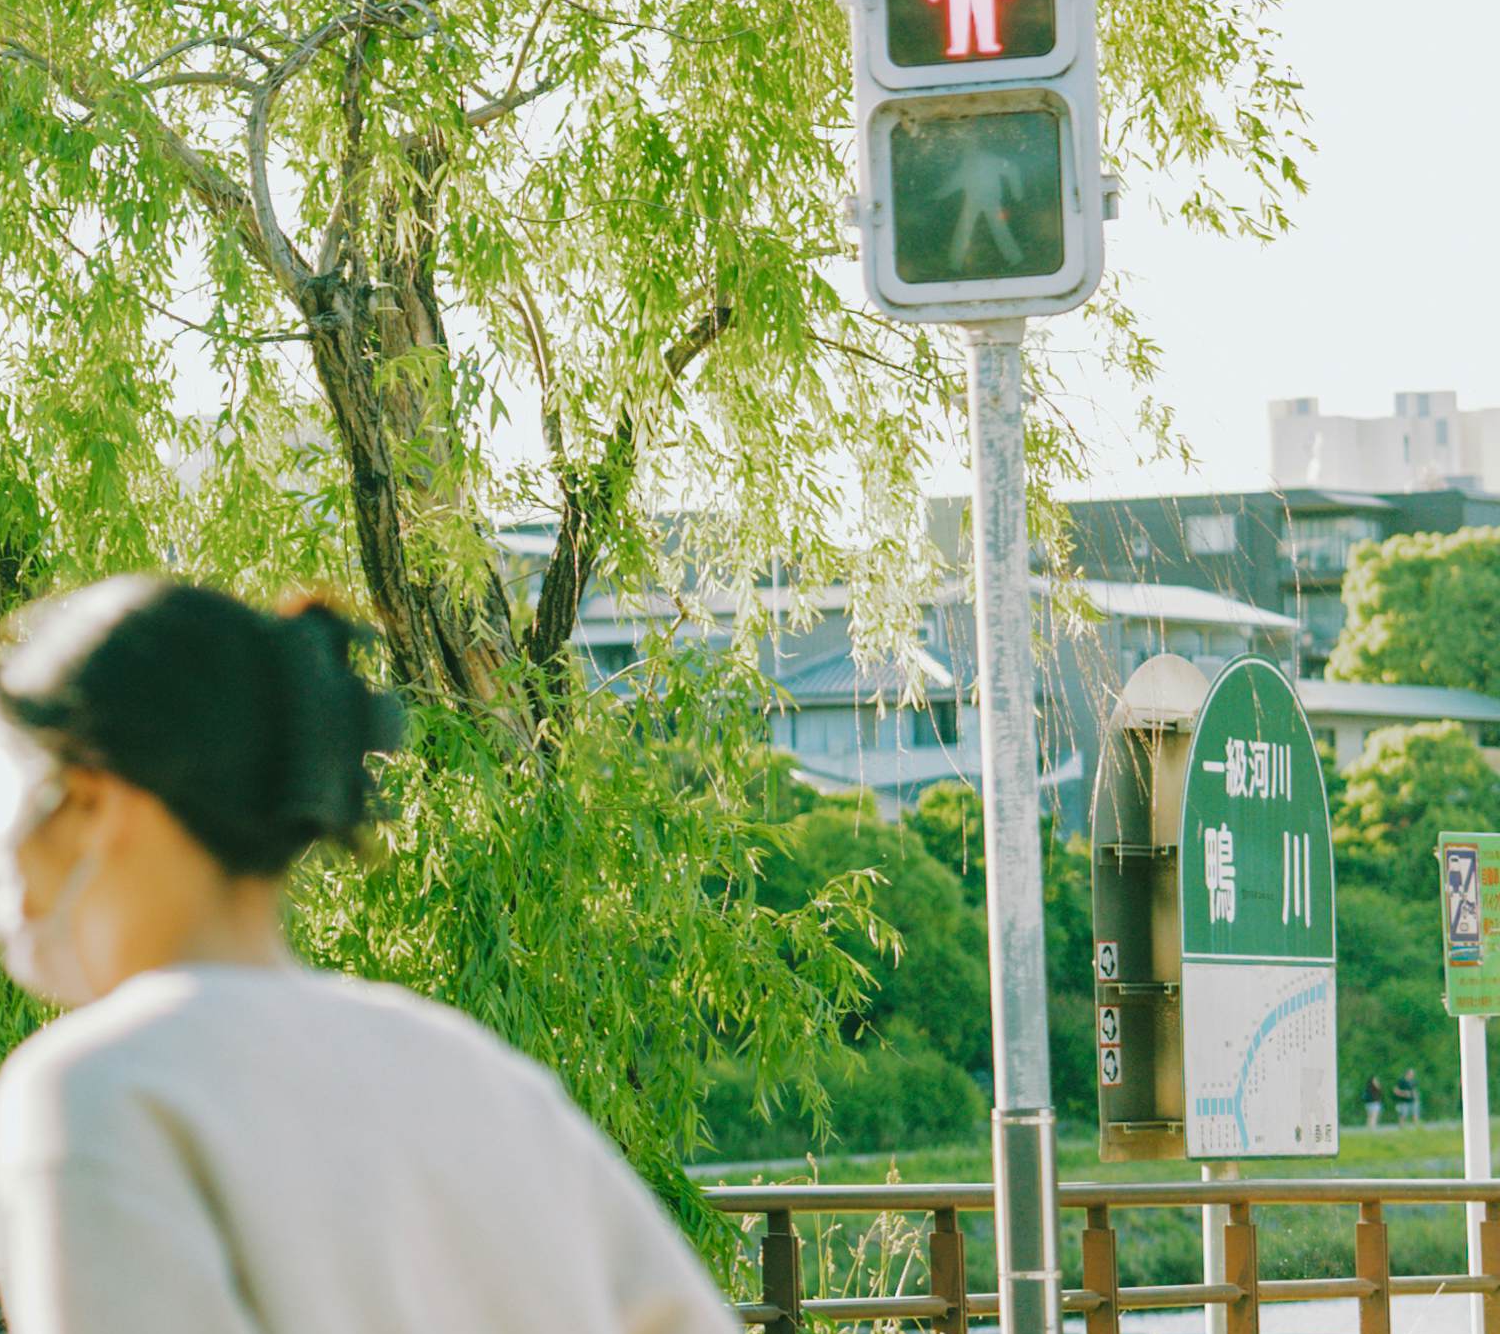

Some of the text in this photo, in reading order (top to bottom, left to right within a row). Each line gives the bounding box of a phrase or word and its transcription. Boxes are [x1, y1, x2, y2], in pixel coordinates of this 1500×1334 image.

[1202, 736, 1292, 802] 一級河川
[1204, 822, 1311, 929] 鴨川
